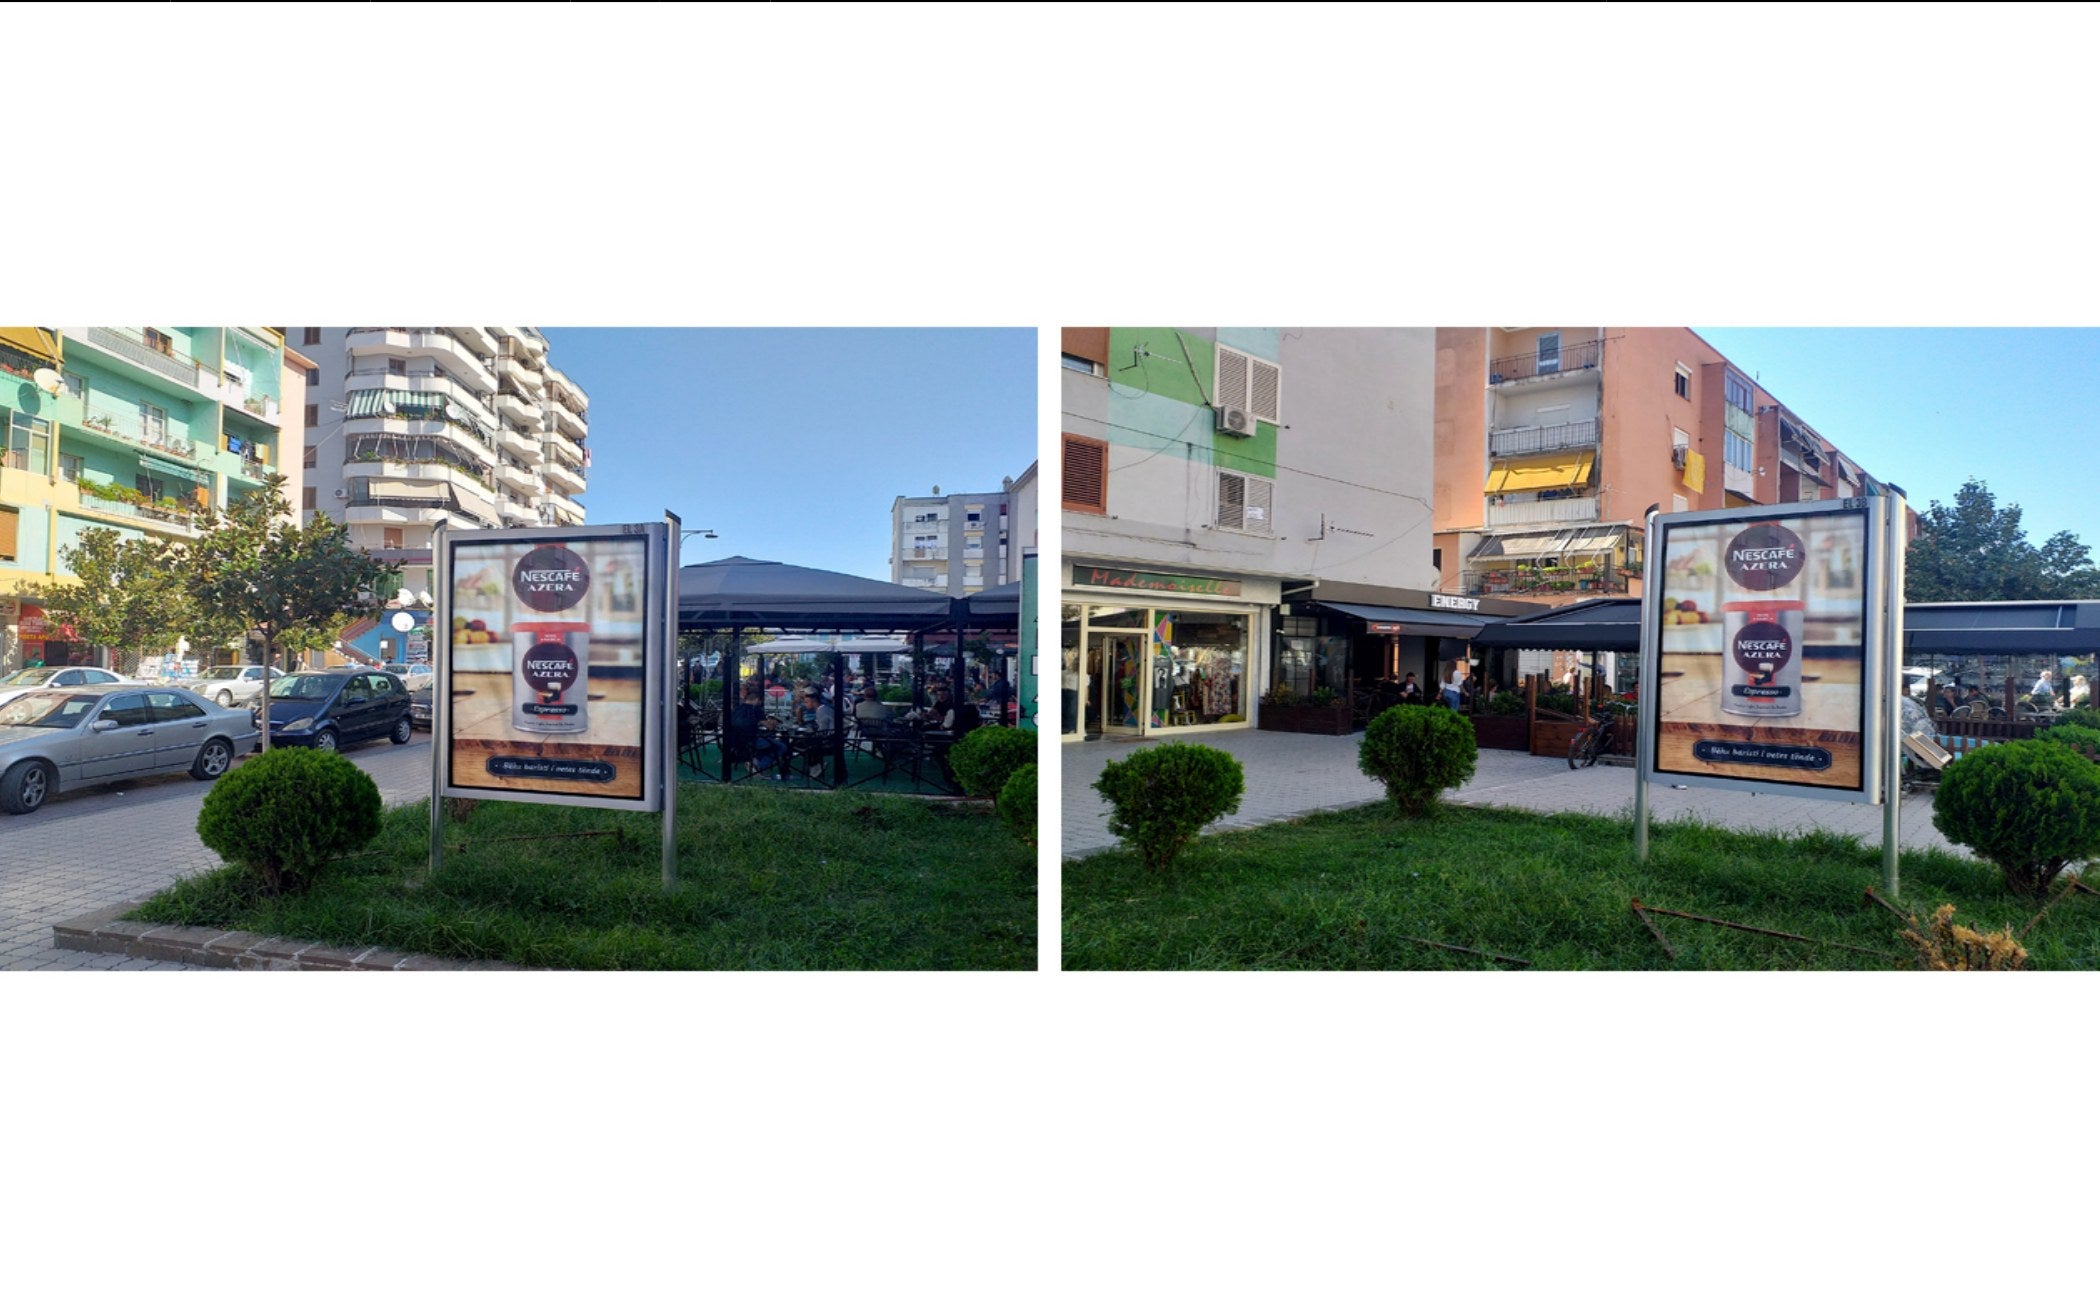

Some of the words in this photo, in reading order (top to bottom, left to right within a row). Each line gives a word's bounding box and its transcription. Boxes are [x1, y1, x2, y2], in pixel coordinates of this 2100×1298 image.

[1732, 543, 1795, 562] NESCAFÉ
[520, 566, 580, 582] NESCAFÉ
[1740, 561, 1788, 571] AZERA
[528, 583, 574, 592] AZERA
[1091, 568, 1233, 595] Mademoiselle
[1431, 594, 1480, 611] ENERGY
[1743, 651, 1782, 659] AZERA
